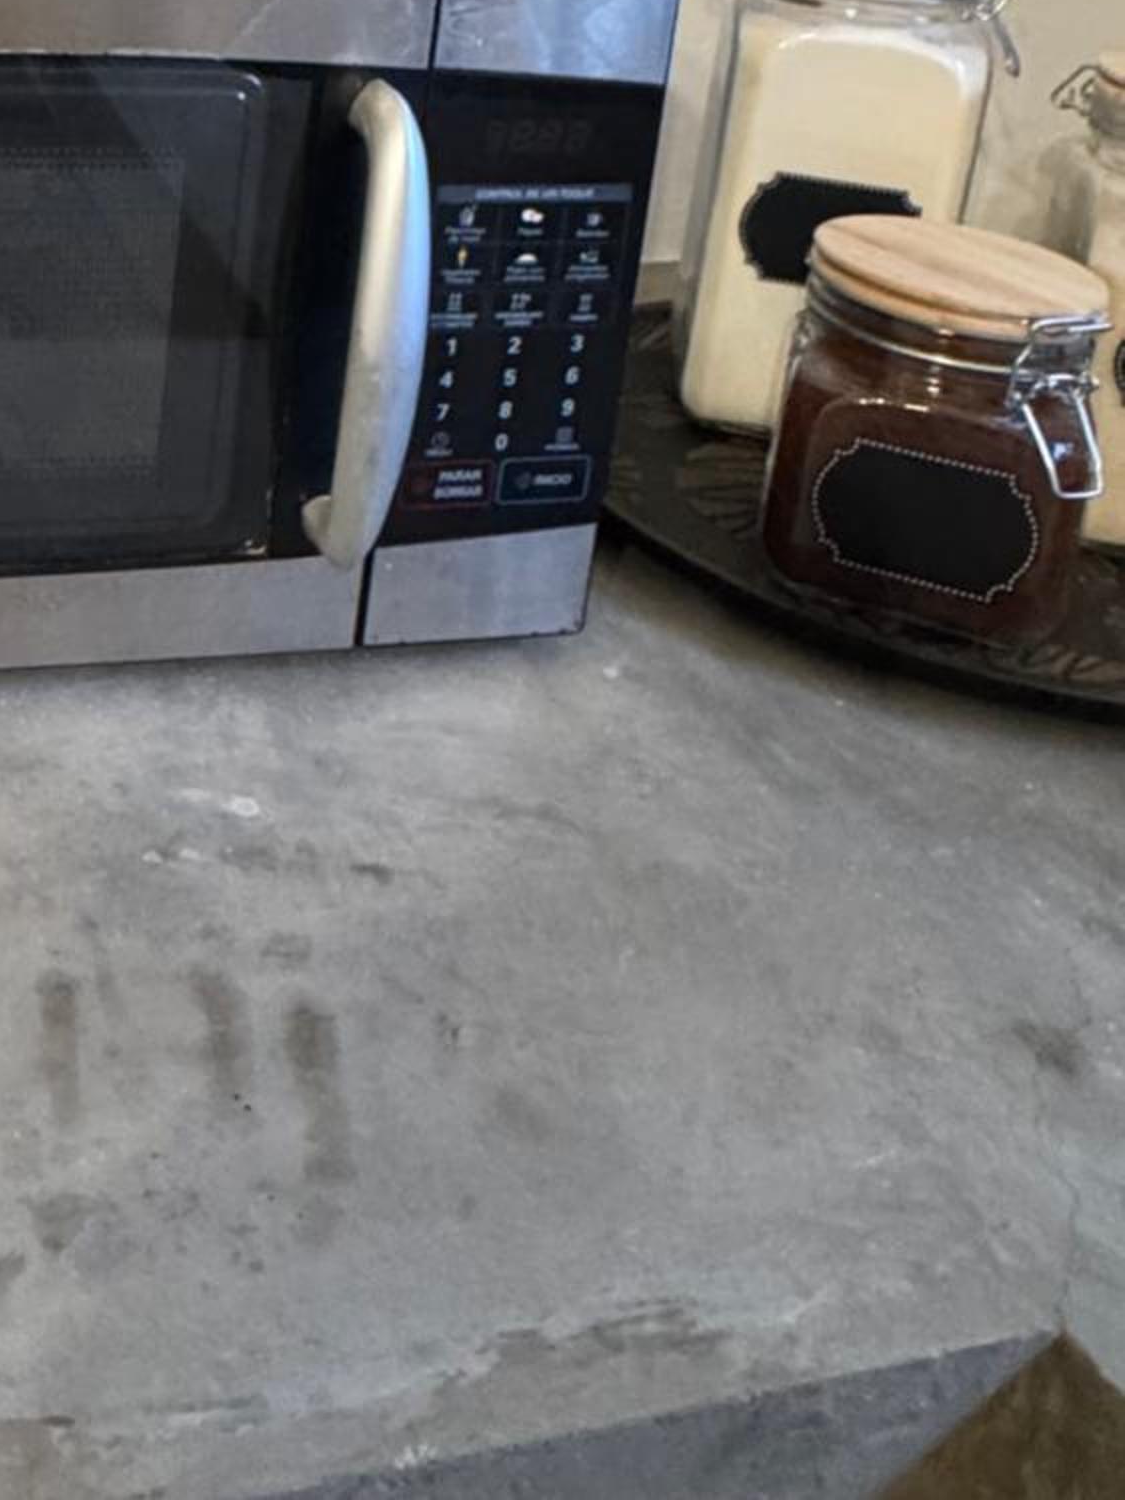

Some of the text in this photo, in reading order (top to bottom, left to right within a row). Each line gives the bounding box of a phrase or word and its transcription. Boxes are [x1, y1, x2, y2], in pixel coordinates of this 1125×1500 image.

[447, 338, 457, 355] 1
[507, 336, 522, 354] 2
[570, 334, 584, 352] 3
[439, 371, 453, 388] 4
[504, 368, 517, 387] 5
[565, 366, 579, 385] 6
[437, 403, 450, 421] 7
[498, 400, 513, 419] 8
[562, 398, 575, 417] 9
[494, 433, 509, 451] 0
